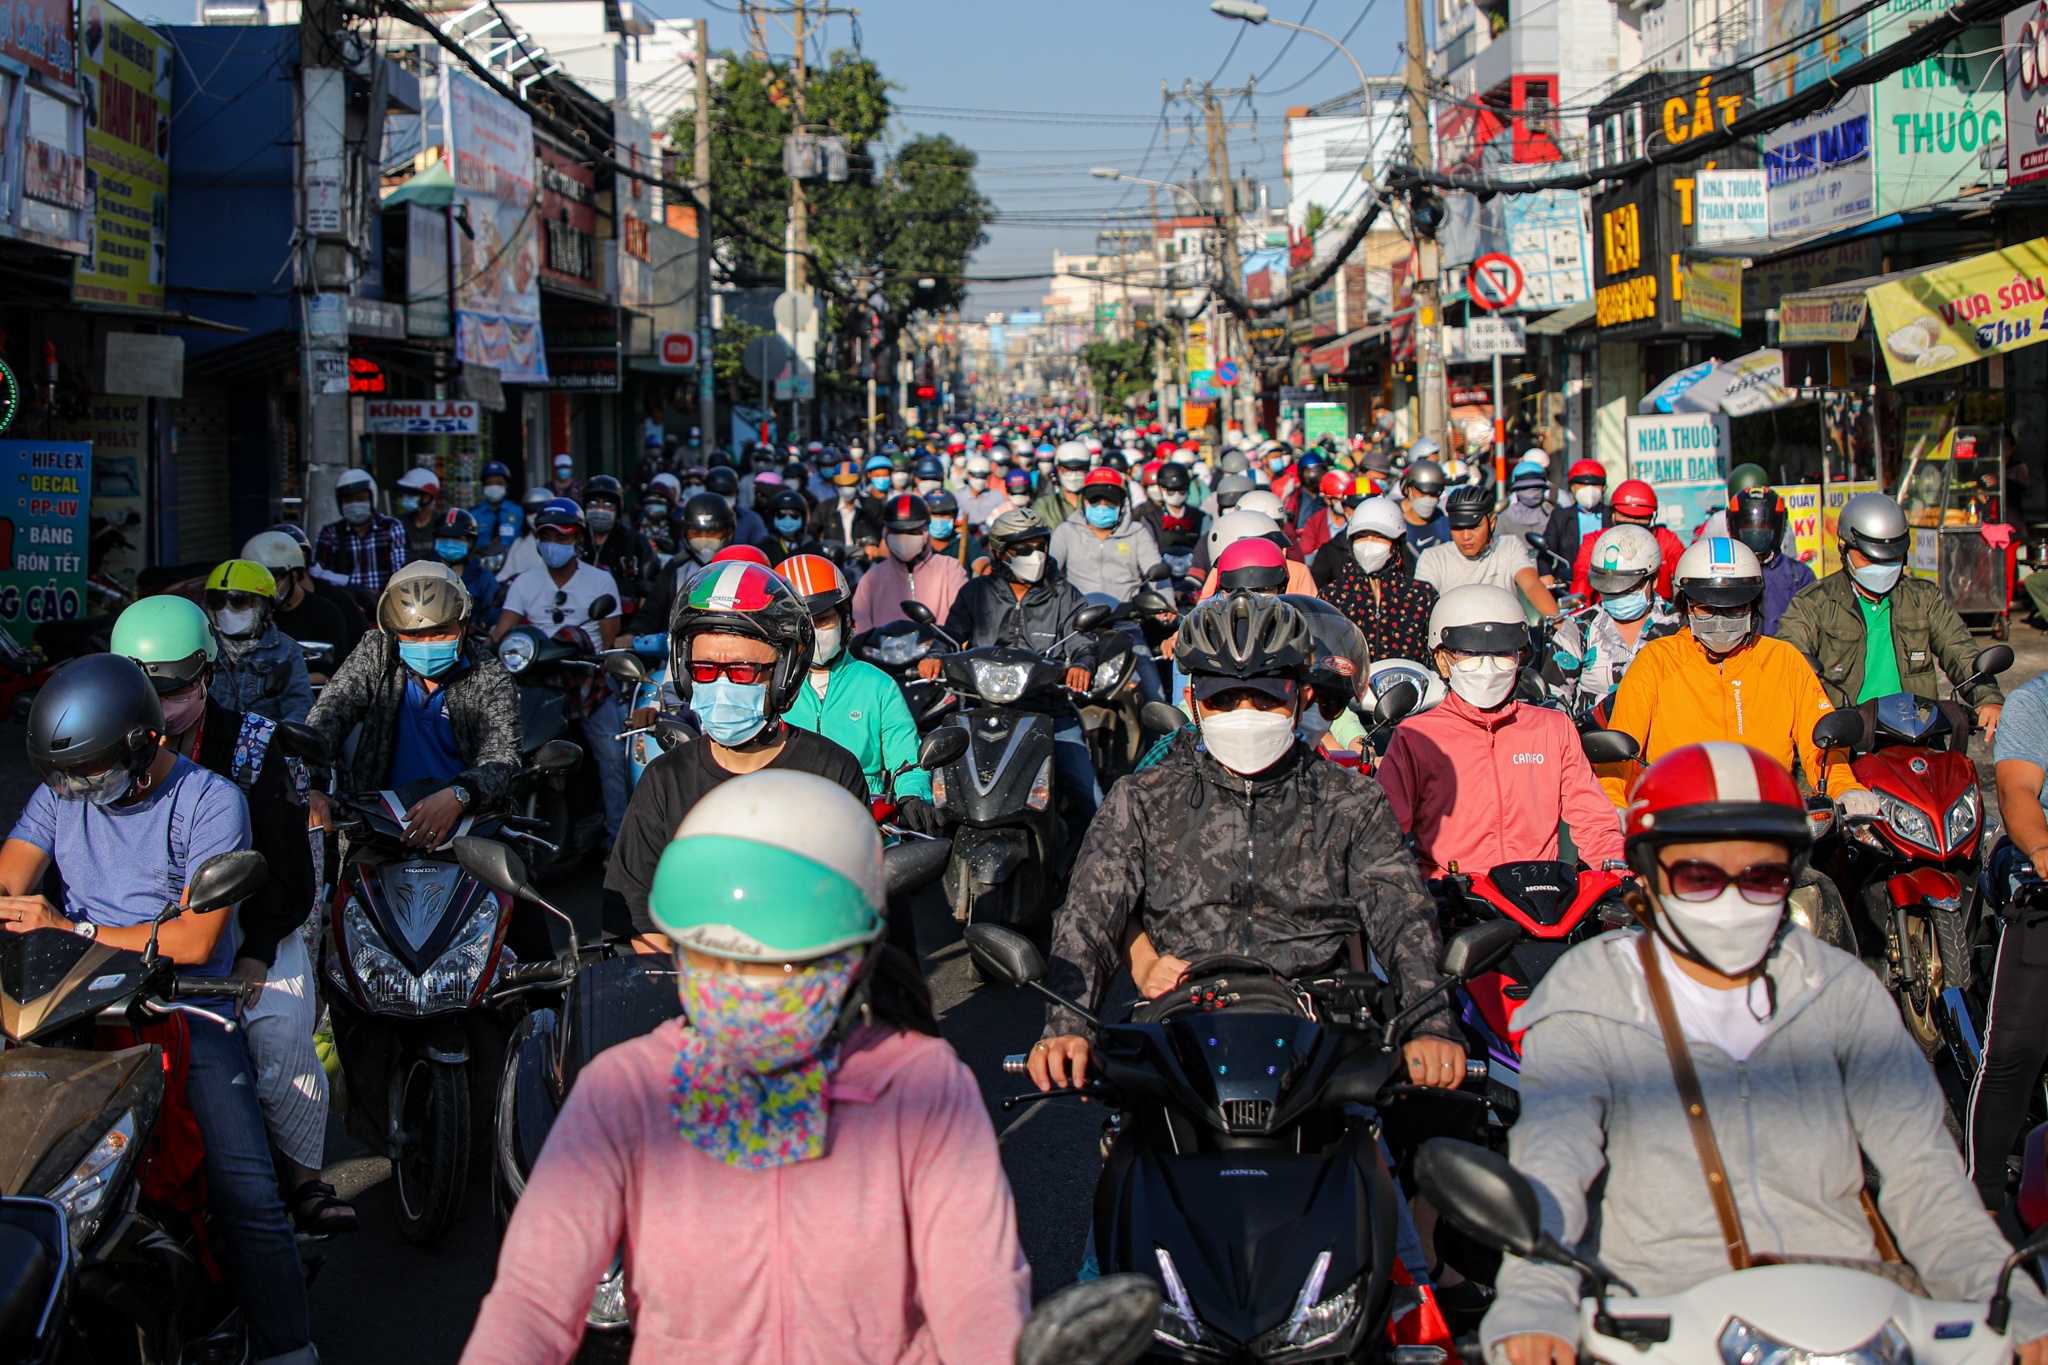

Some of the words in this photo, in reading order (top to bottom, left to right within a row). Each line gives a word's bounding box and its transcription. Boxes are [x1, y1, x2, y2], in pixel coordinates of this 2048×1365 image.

[1663, 75, 1742, 145] CẮT
[1892, 91, 2002, 155] THUỐC
[1727, 173, 1762, 197] THUỐC
[1699, 202, 1734, 219] THANH
[1938, 292, 1991, 328] VỰA
[1974, 318, 2032, 350] Thu
[370, 401, 422, 418] KÍNH
[430, 401, 474, 418] LÃO
[407, 418, 469, 432] 25k
[1638, 424, 1668, 452] NHÀ
[1672, 416, 1722, 450] THUỐC
[31, 452, 85, 470] HIFLEX
[1635, 458, 1683, 483] THANH
[1688, 455, 1728, 482] DANH
[30, 475, 80, 494] DECAL
[29, 499, 78, 517] PP-UV
[1789, 493, 1816, 509] QUAY
[1794, 514, 1816, 537] KÝ
[16, 551, 52, 572] RÔN
[55, 549, 81, 573] TẾT
[25, 578, 80, 623] CÁO
[1525, 884, 1560, 892] HONDA
[1219, 1169, 1270, 1177] HONDA
